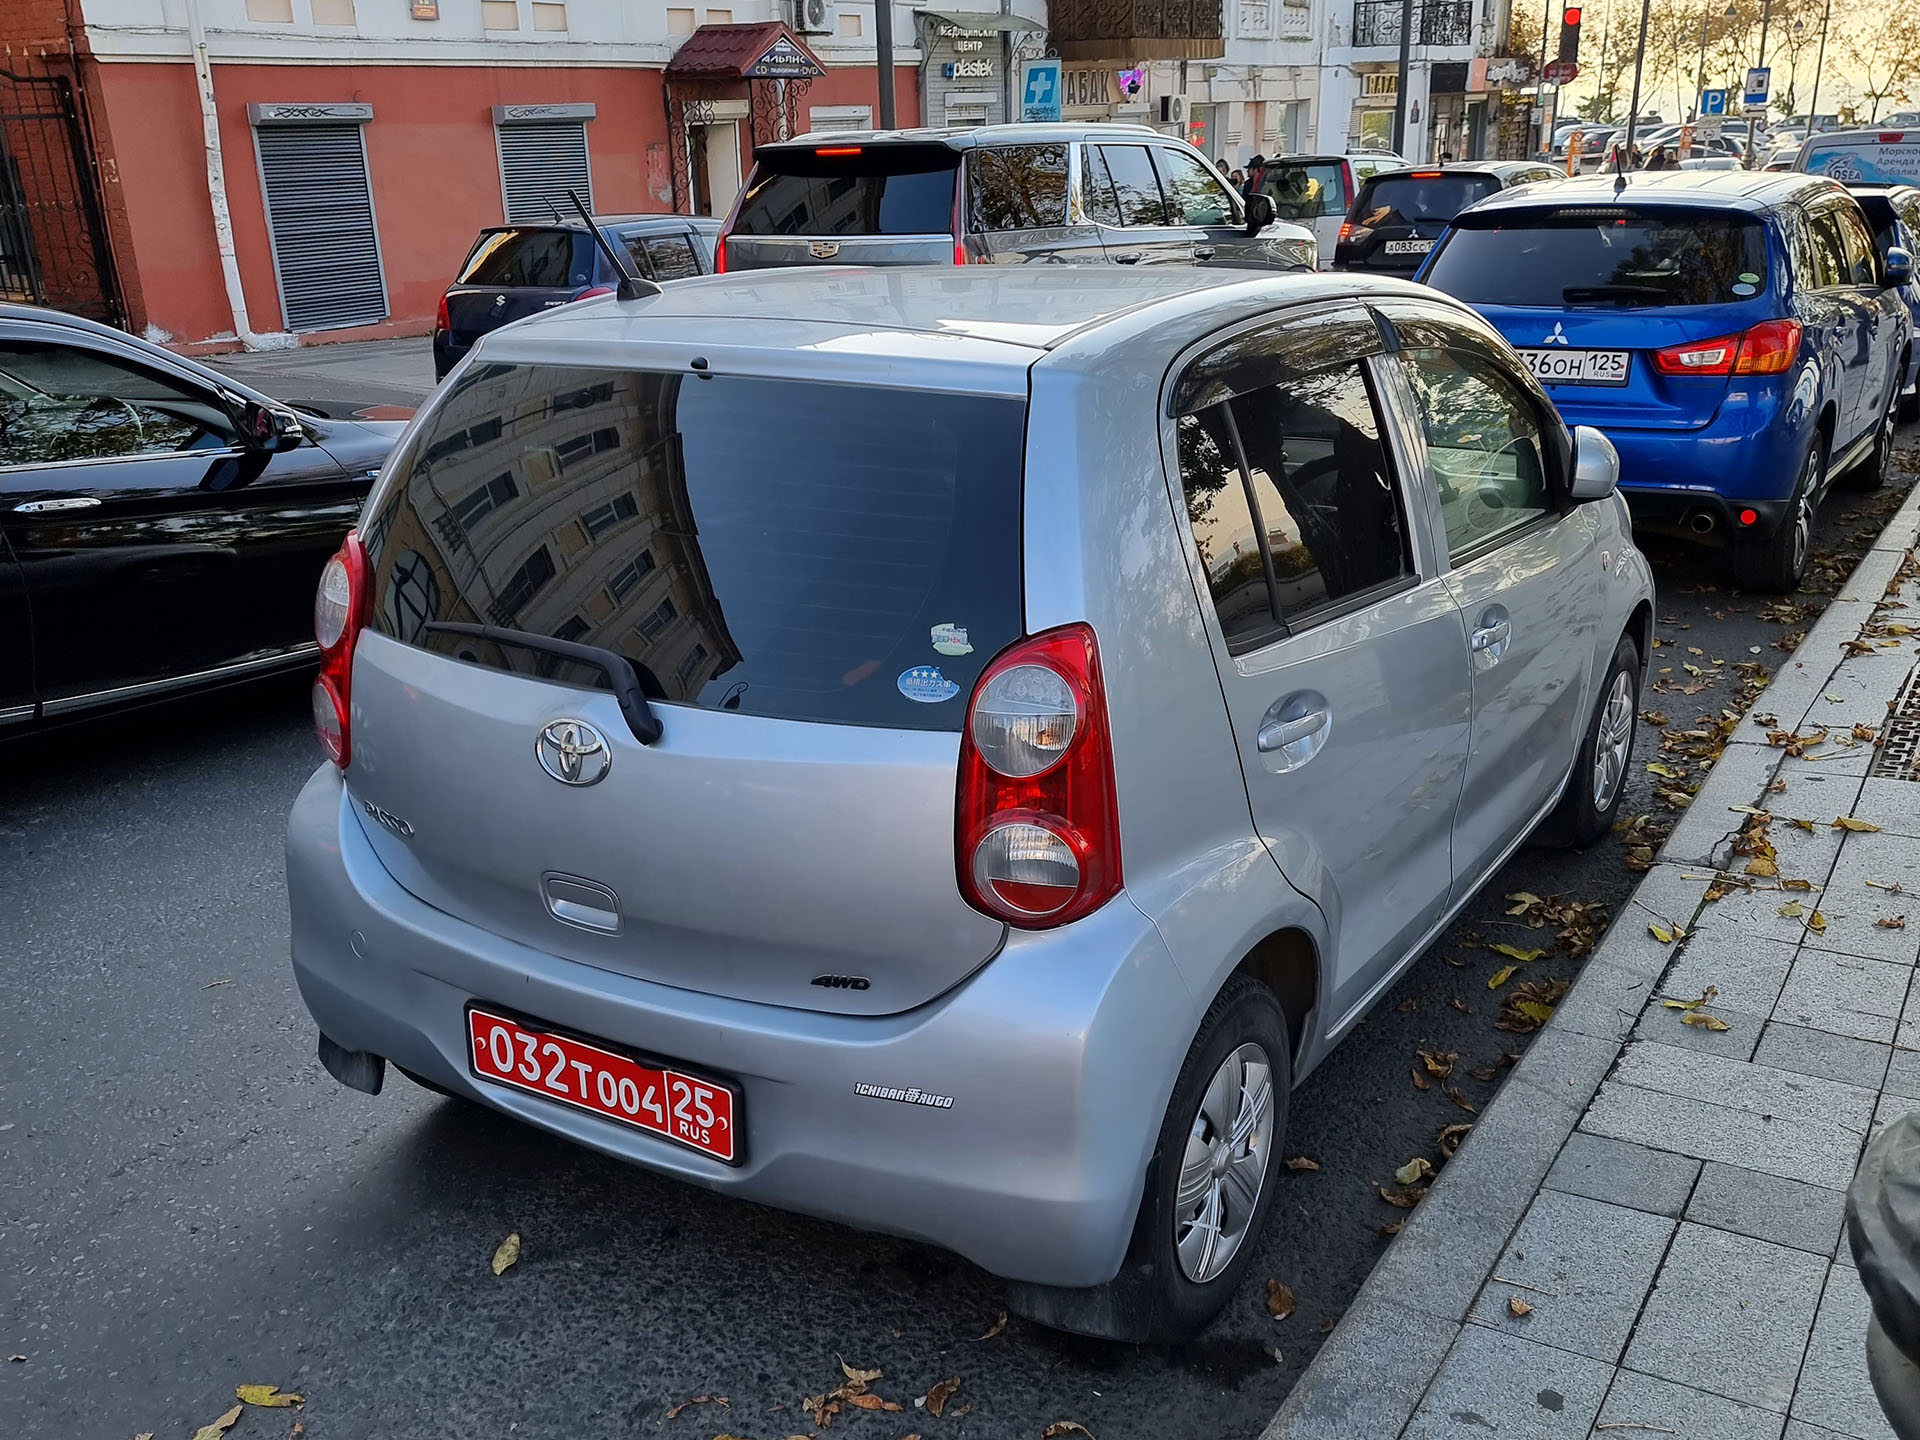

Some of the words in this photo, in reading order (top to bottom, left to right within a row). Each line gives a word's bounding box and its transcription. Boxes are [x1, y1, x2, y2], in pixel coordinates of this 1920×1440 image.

[957, 40, 983, 53] ЦЕНТР
[761, 54, 806, 64] АЛЬЯНС
[755, 65, 767, 75] CD
[802, 66, 818, 75] DVD
[953, 58, 994, 81] plastek
[1024, 105, 1057, 116] plastek
[1519, 352, 1583, 376] 36OH
[1588, 354, 1622, 371] 125
[1593, 370, 1610, 378] RUS
[810, 973, 871, 991] 4WD
[672, 1081, 716, 1128] 25
[679, 1121, 711, 1145] RUS
